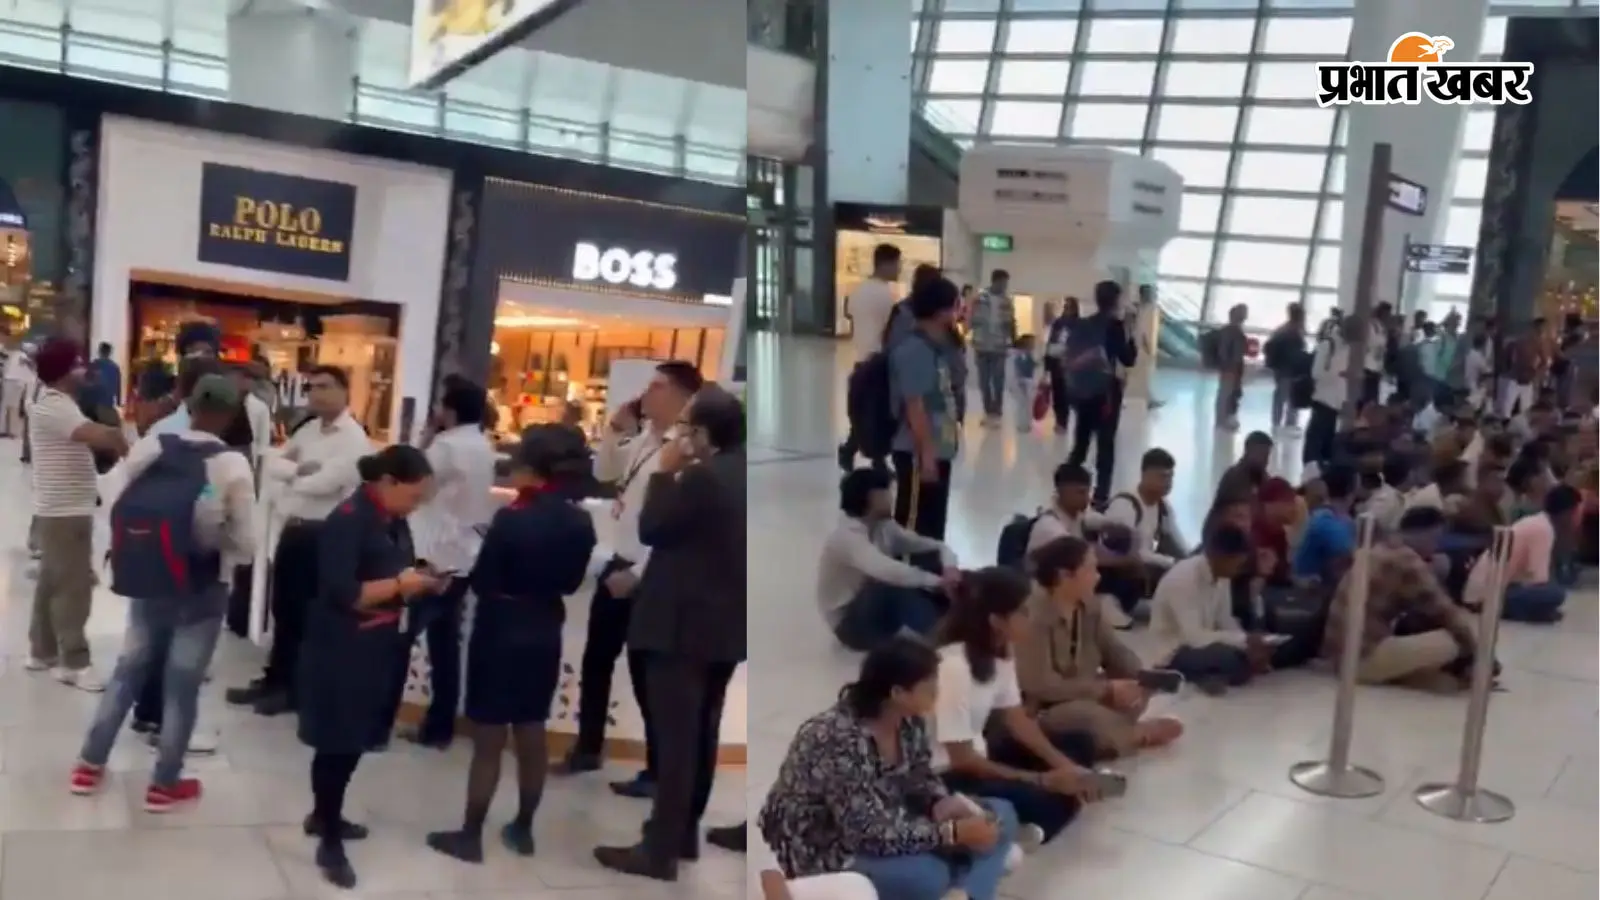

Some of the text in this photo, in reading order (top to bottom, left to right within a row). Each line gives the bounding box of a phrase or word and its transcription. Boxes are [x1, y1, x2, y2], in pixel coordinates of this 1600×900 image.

[209, 222, 267, 244] RALPH
[233, 196, 322, 235] POLO
[572, 242, 677, 290] BOSS
